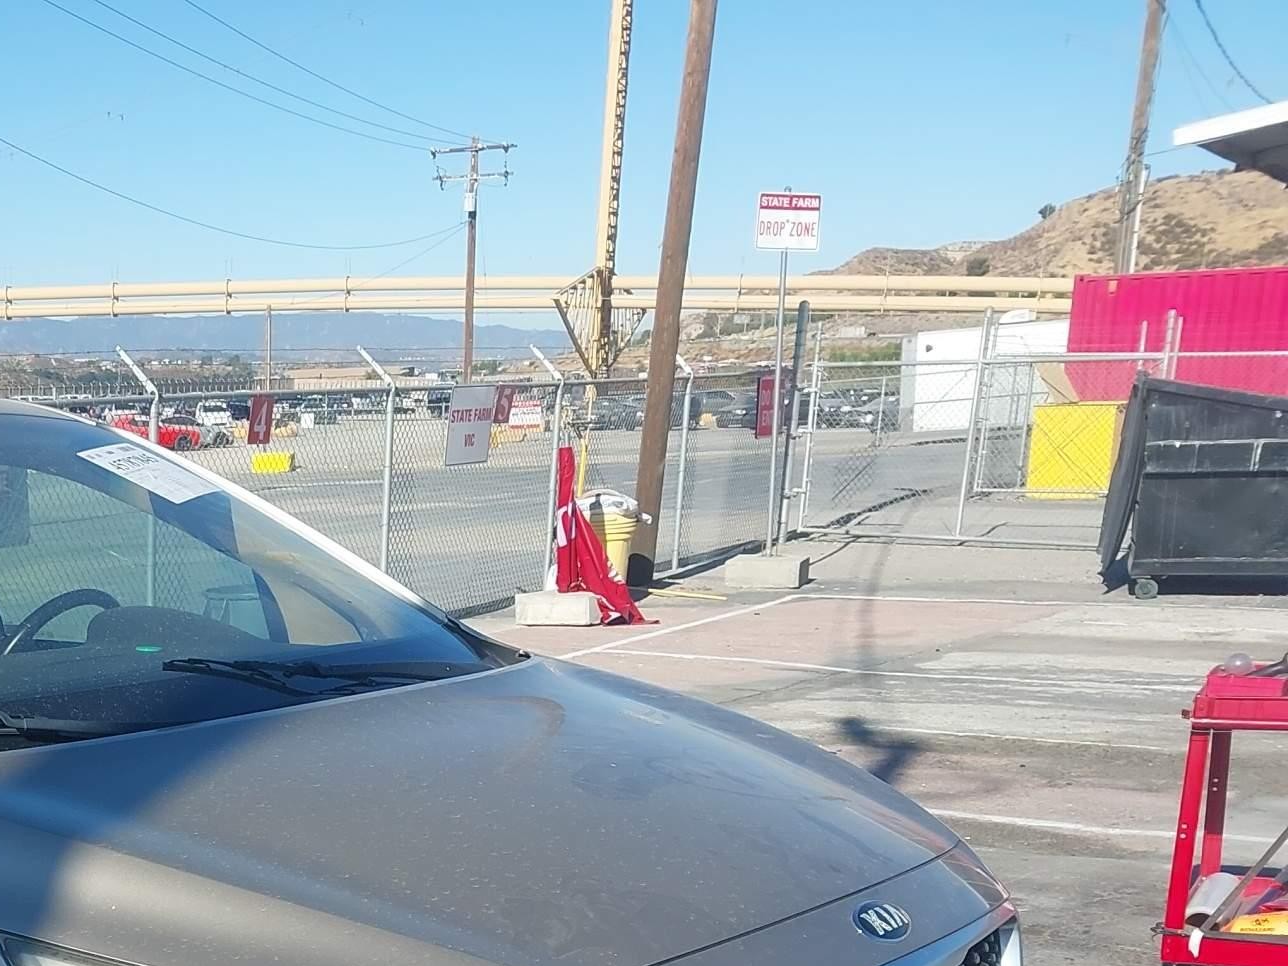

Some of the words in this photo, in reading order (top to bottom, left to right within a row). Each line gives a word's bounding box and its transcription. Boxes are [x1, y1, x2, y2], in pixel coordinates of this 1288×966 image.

[761, 196, 791, 208] STATE
[792, 197, 820, 209] FARM
[759, 220, 786, 237] DROP
[789, 221, 817, 238] ZONE
[500, 388, 513, 421] 5
[253, 400, 268, 441] 4
[451, 408, 473, 424] STATE
[473, 407, 493, 422] FARM
[464, 432, 476, 448] VIC
[858, 903, 910, 936] KIA
